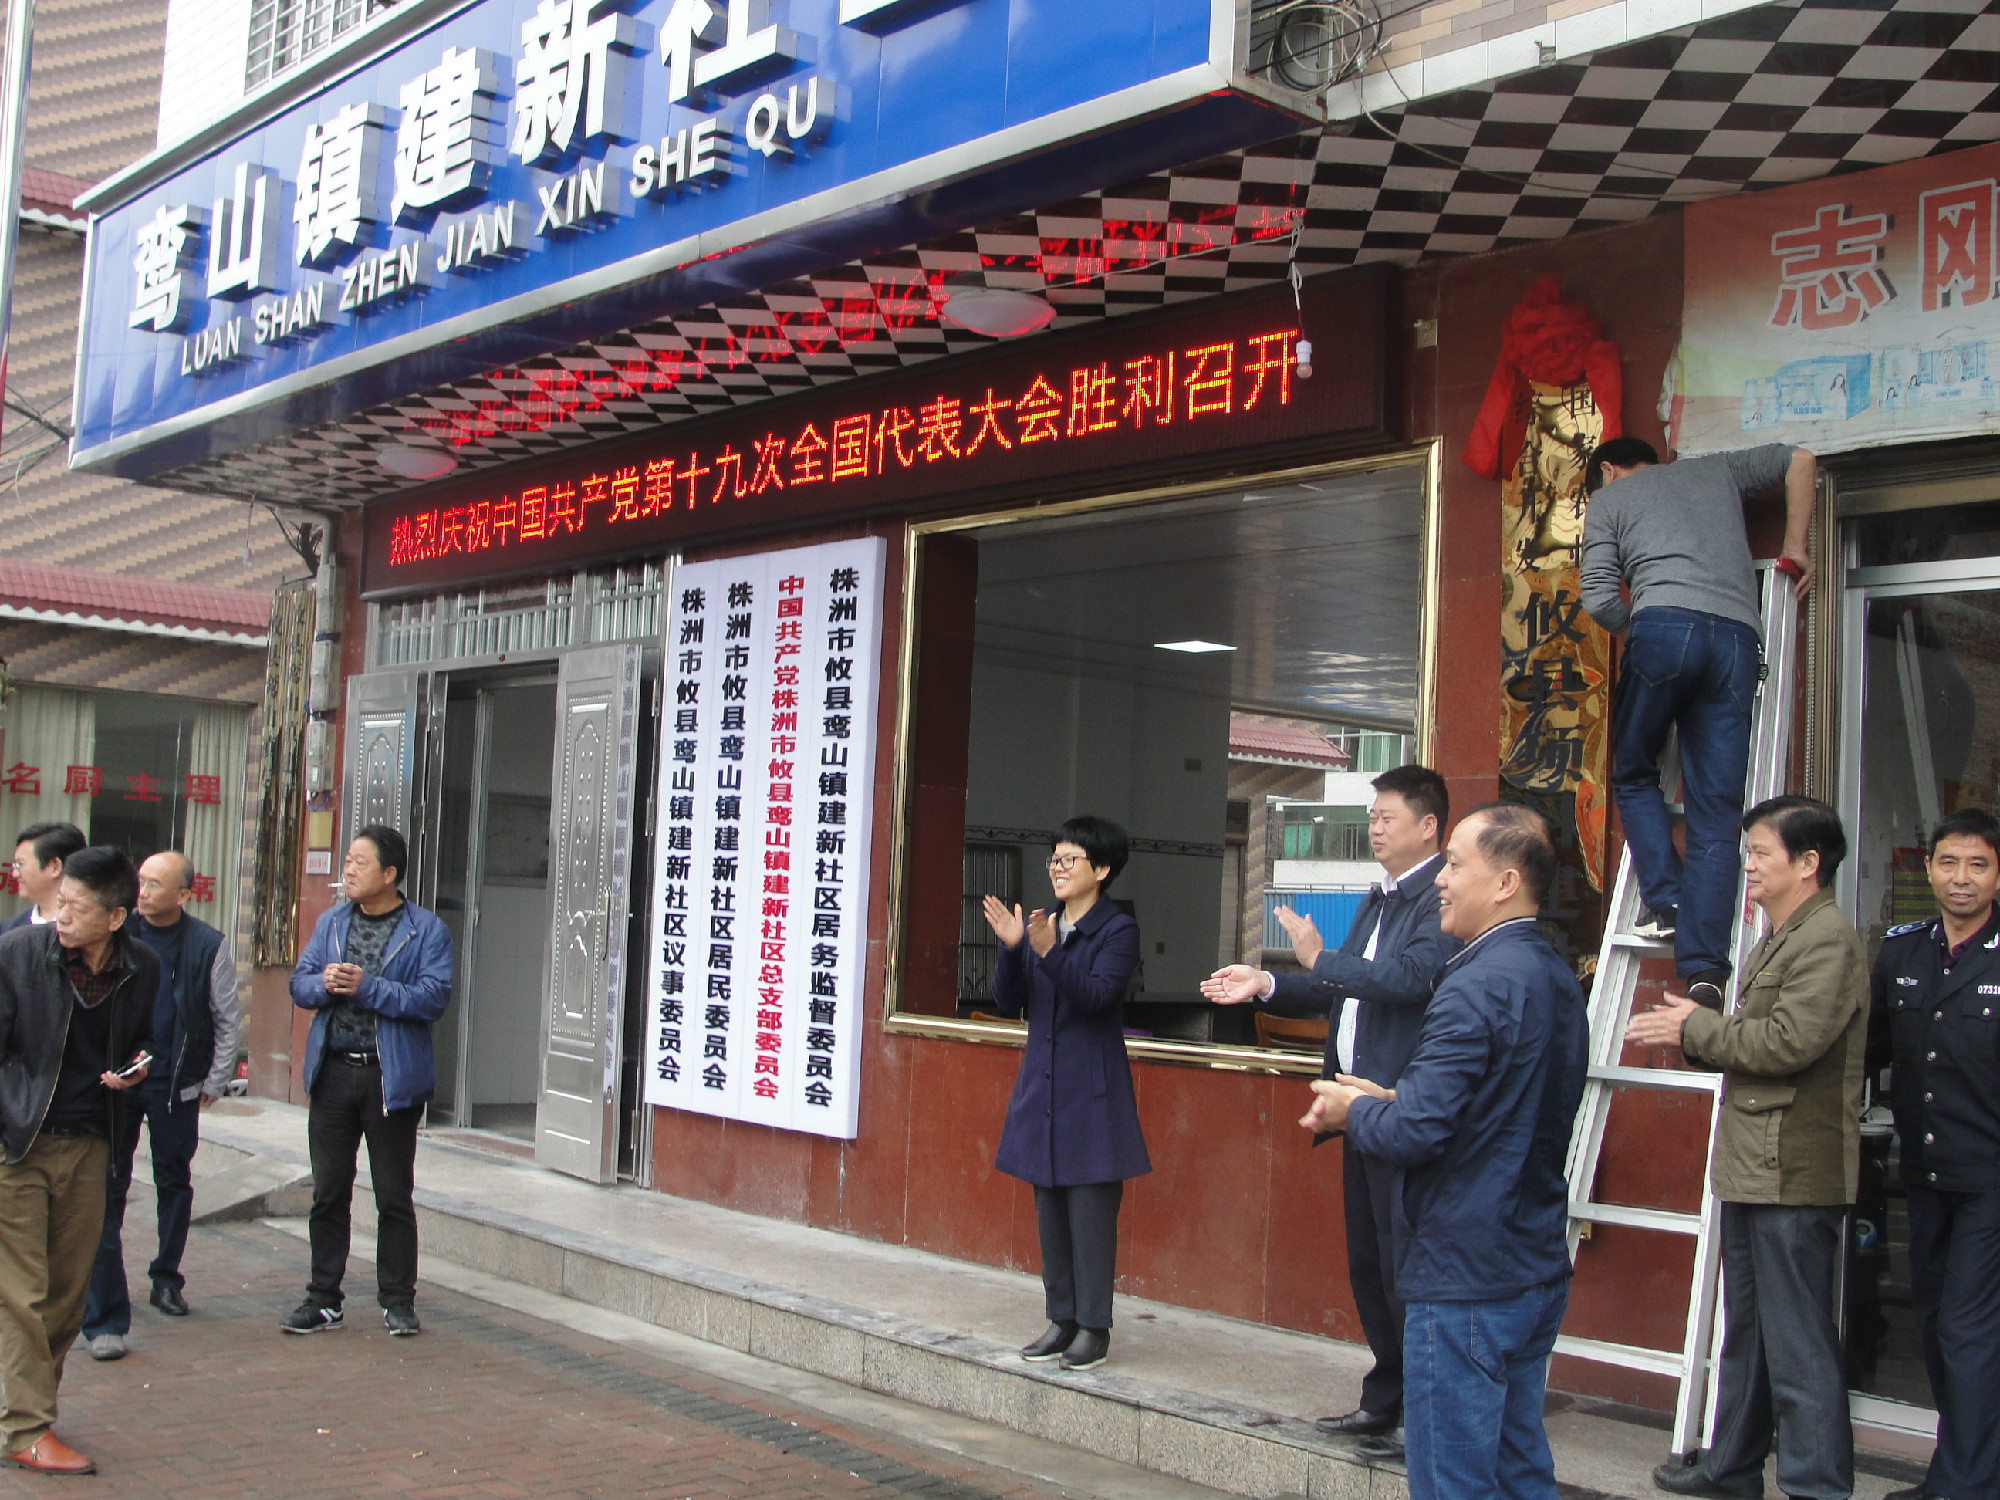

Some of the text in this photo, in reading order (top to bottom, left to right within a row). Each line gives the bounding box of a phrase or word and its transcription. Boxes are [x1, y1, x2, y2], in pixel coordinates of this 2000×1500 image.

[180, 76, 818, 377] LUAN SHAN ZHEN JIAN XIN SHE QU
[389, 328, 1298, 566] 热烈庆祝中国共产党第十九次全国代表大会胜利召开
[2, 762, 221, 805] 名厨主理
[656, 587, 706, 1082] 株洲市攸县鸾山镇建新社区议事委员会
[702, 582, 753, 1090] 株洲市攸县鸾山镇建新社区居民委员会
[753, 575, 805, 1099] 中国共产党株洲市攸县鸾山镇建新社区总支部委员会
[805, 567, 860, 1107] 株洲市攸县鸾山镇建新社区居务监督委员会
